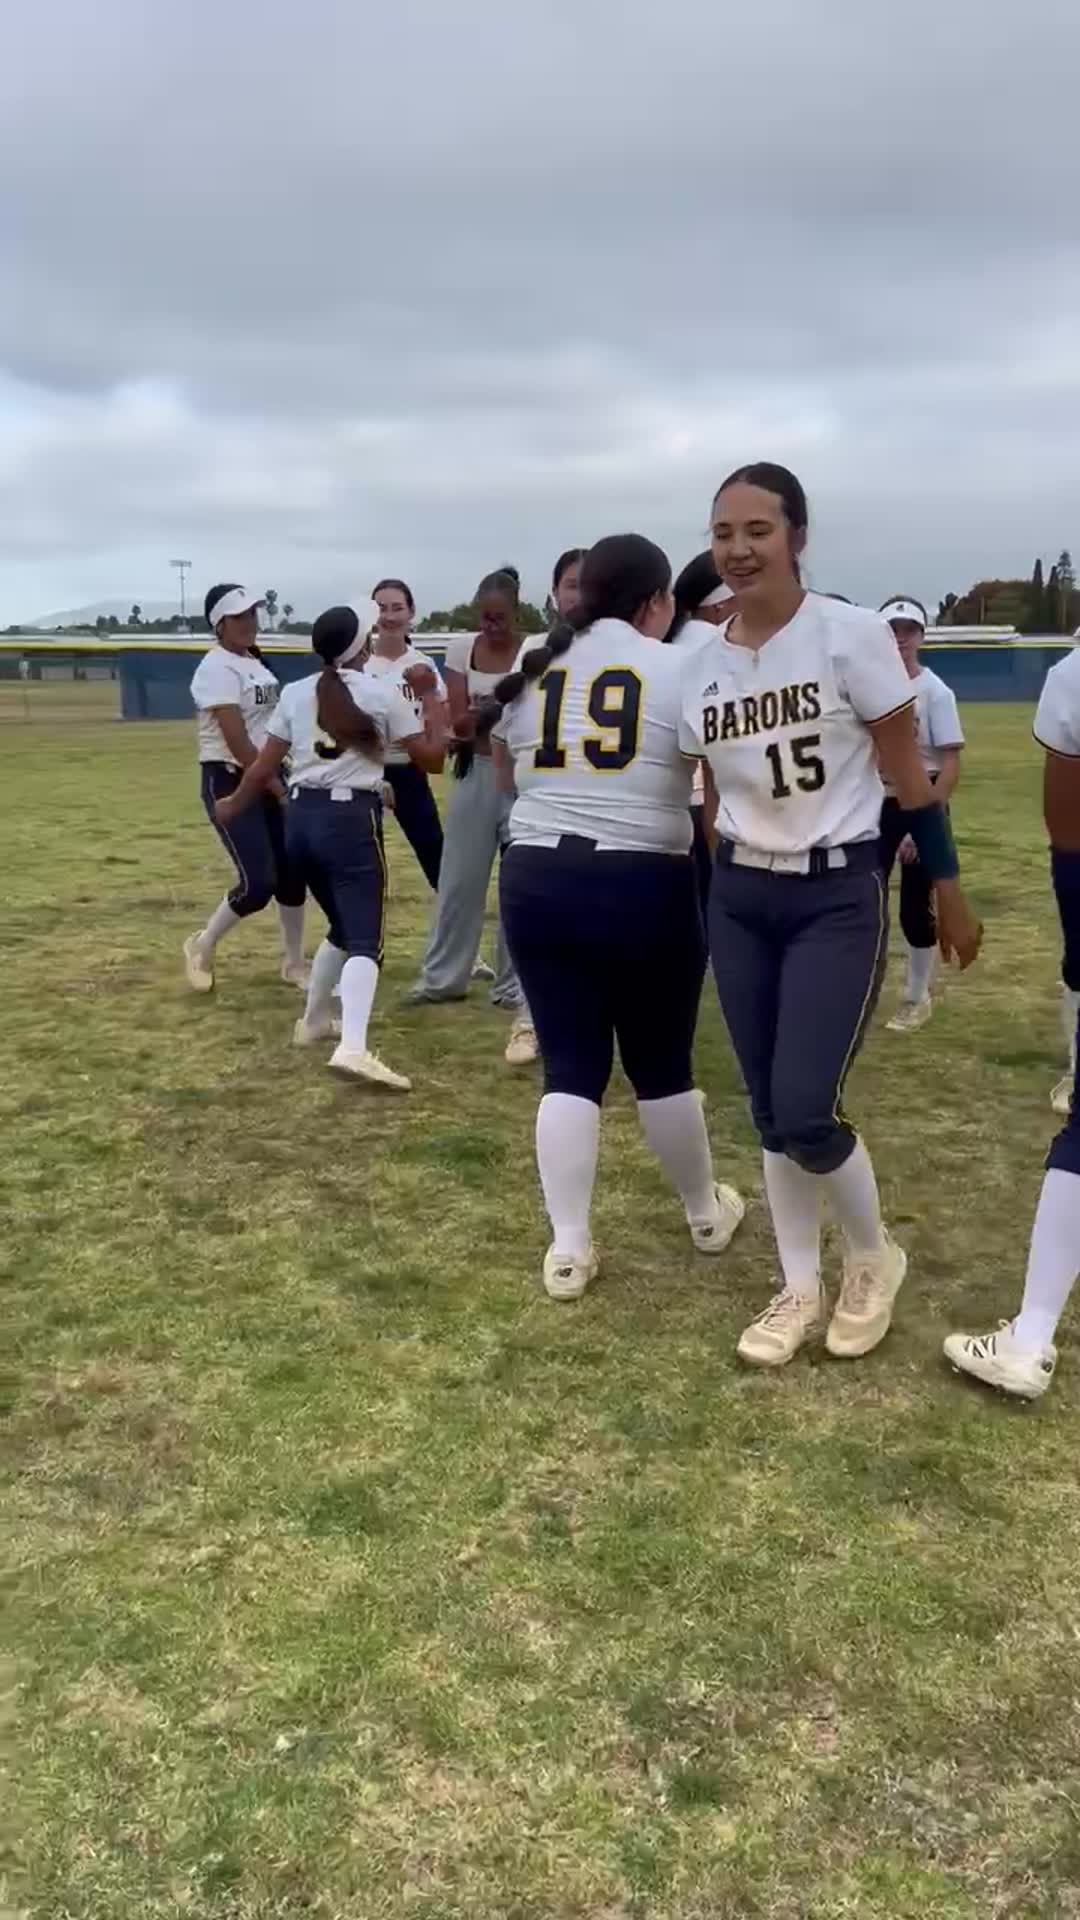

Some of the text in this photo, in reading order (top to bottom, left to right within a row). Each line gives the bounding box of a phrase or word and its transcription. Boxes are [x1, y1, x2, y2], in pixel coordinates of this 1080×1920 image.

[532, 667, 645, 773] 19
[702, 681, 821, 745] BARONS
[765, 735, 826, 799] 15
